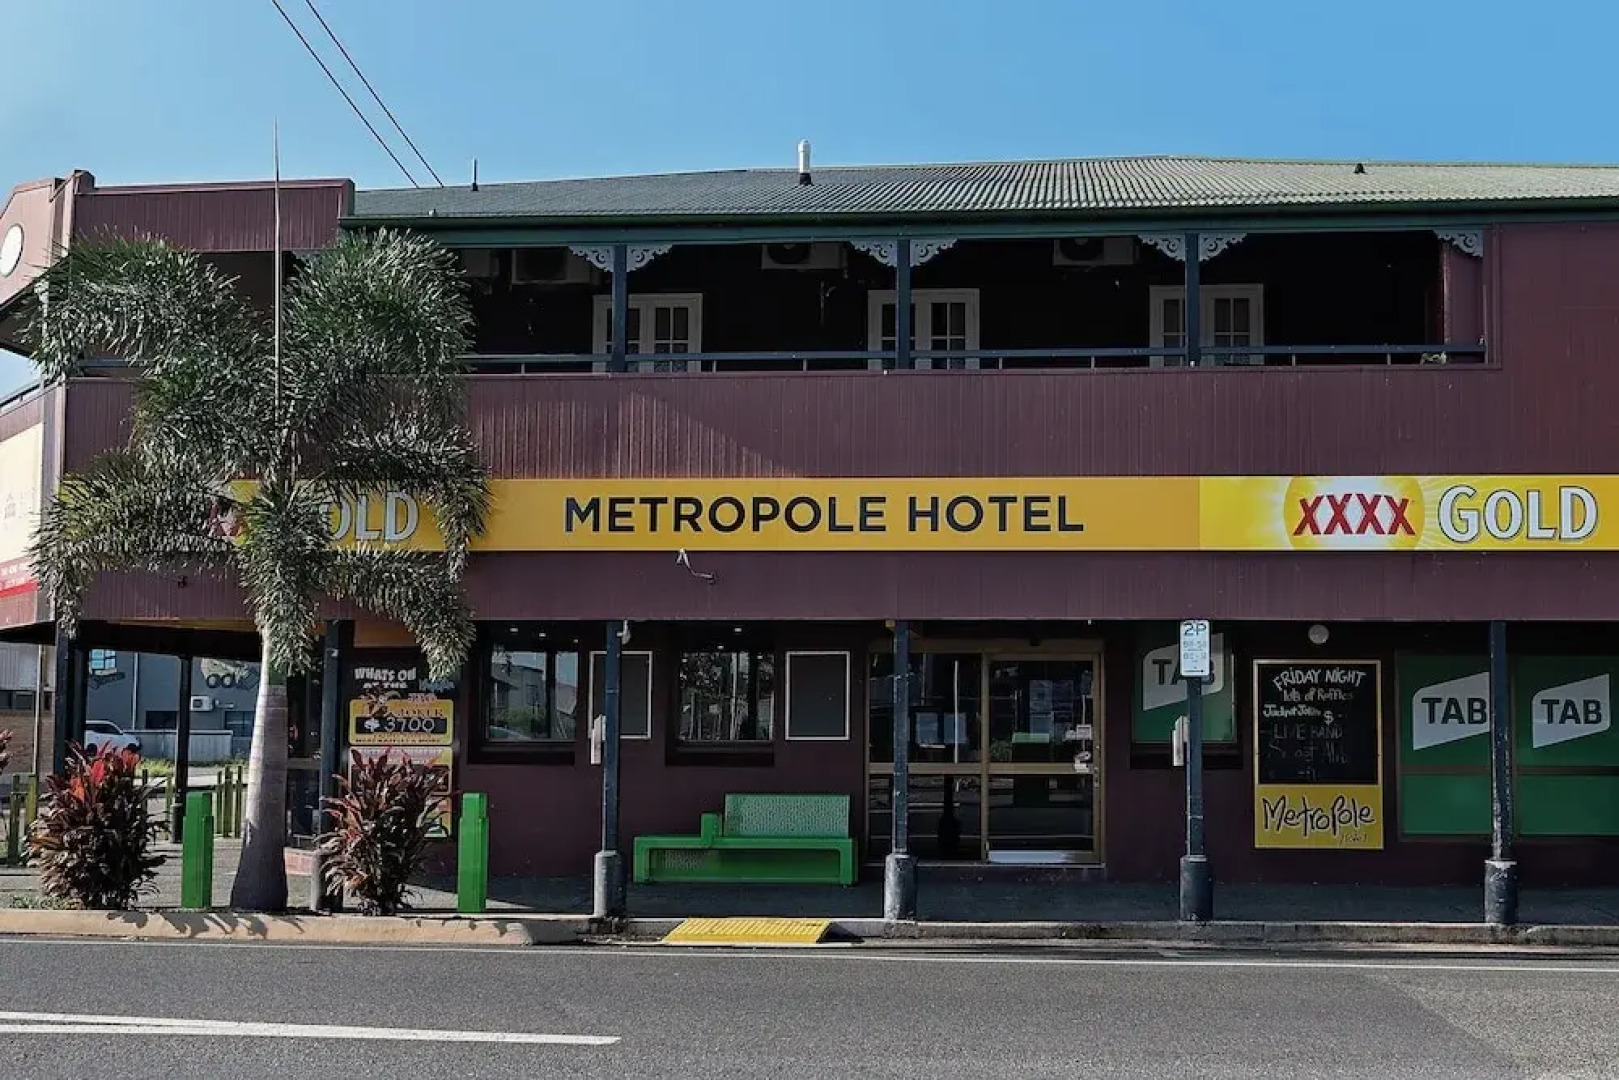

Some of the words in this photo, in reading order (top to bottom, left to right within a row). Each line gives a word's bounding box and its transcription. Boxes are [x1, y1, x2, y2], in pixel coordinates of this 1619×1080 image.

[319, 490, 419, 541] OLD
[565, 496, 886, 533] METROPOLE
[907, 495, 1084, 532] HOTEL
[1293, 493, 1416, 536] XXXX
[1437, 484, 1599, 543] GOLD
[1183, 622, 1207, 636] 2P
[1421, 697, 1487, 725] TAB
[1540, 699, 1602, 725] TAB
